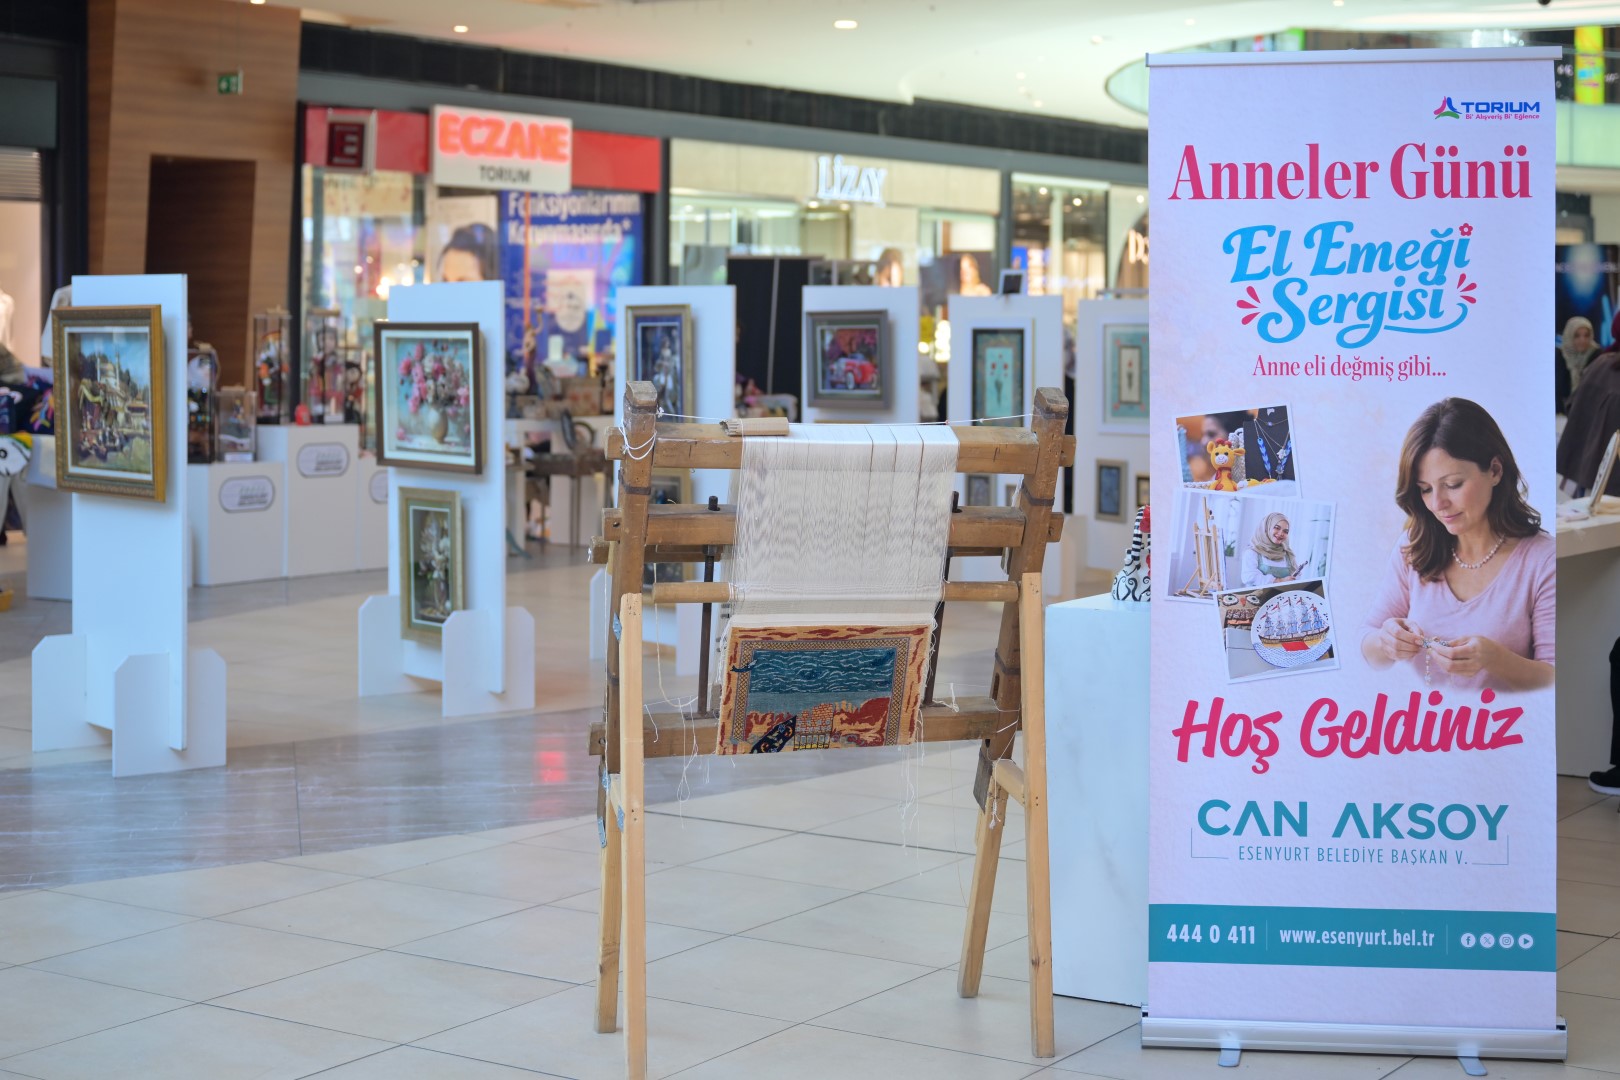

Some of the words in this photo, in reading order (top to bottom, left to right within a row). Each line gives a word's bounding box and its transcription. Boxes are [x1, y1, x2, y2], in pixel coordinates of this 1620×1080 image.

[1460, 101, 1540, 113] TORIUM
[1514, 113, 1540, 121] Eğlence
[437, 112, 570, 163] ECZANE
[479, 165, 531, 184] TORIUM
[1168, 143, 1380, 201] Anneler
[1389, 142, 1532, 200] Günü
[1222, 224, 1293, 284] El
[1303, 220, 1474, 287] Emeği
[1256, 276, 1469, 350] Sergisi
[1253, 354, 1300, 376] Anne
[1304, 354, 1326, 376] eli
[1330, 356, 1394, 382] değmiş
[1397, 355, 1447, 381] gibi...
[1171, 696, 1283, 775] Hoş
[1299, 687, 1524, 759] Geldiniz
[1197, 799, 1309, 837] CAN
[1331, 802, 1509, 841] AKSOY
[1238, 845, 1310, 862] ESENYURT
[1316, 845, 1384, 864] BELEDİYE
[1390, 847, 1448, 866] BAŞKAN
[1455, 849, 1469, 865] V.
[1166, 923, 1203, 943] 444
[1209, 924, 1221, 943] 0
[1227, 925, 1256, 945] 411
[1279, 928, 1435, 948] www.esenyurt.bel.tr
